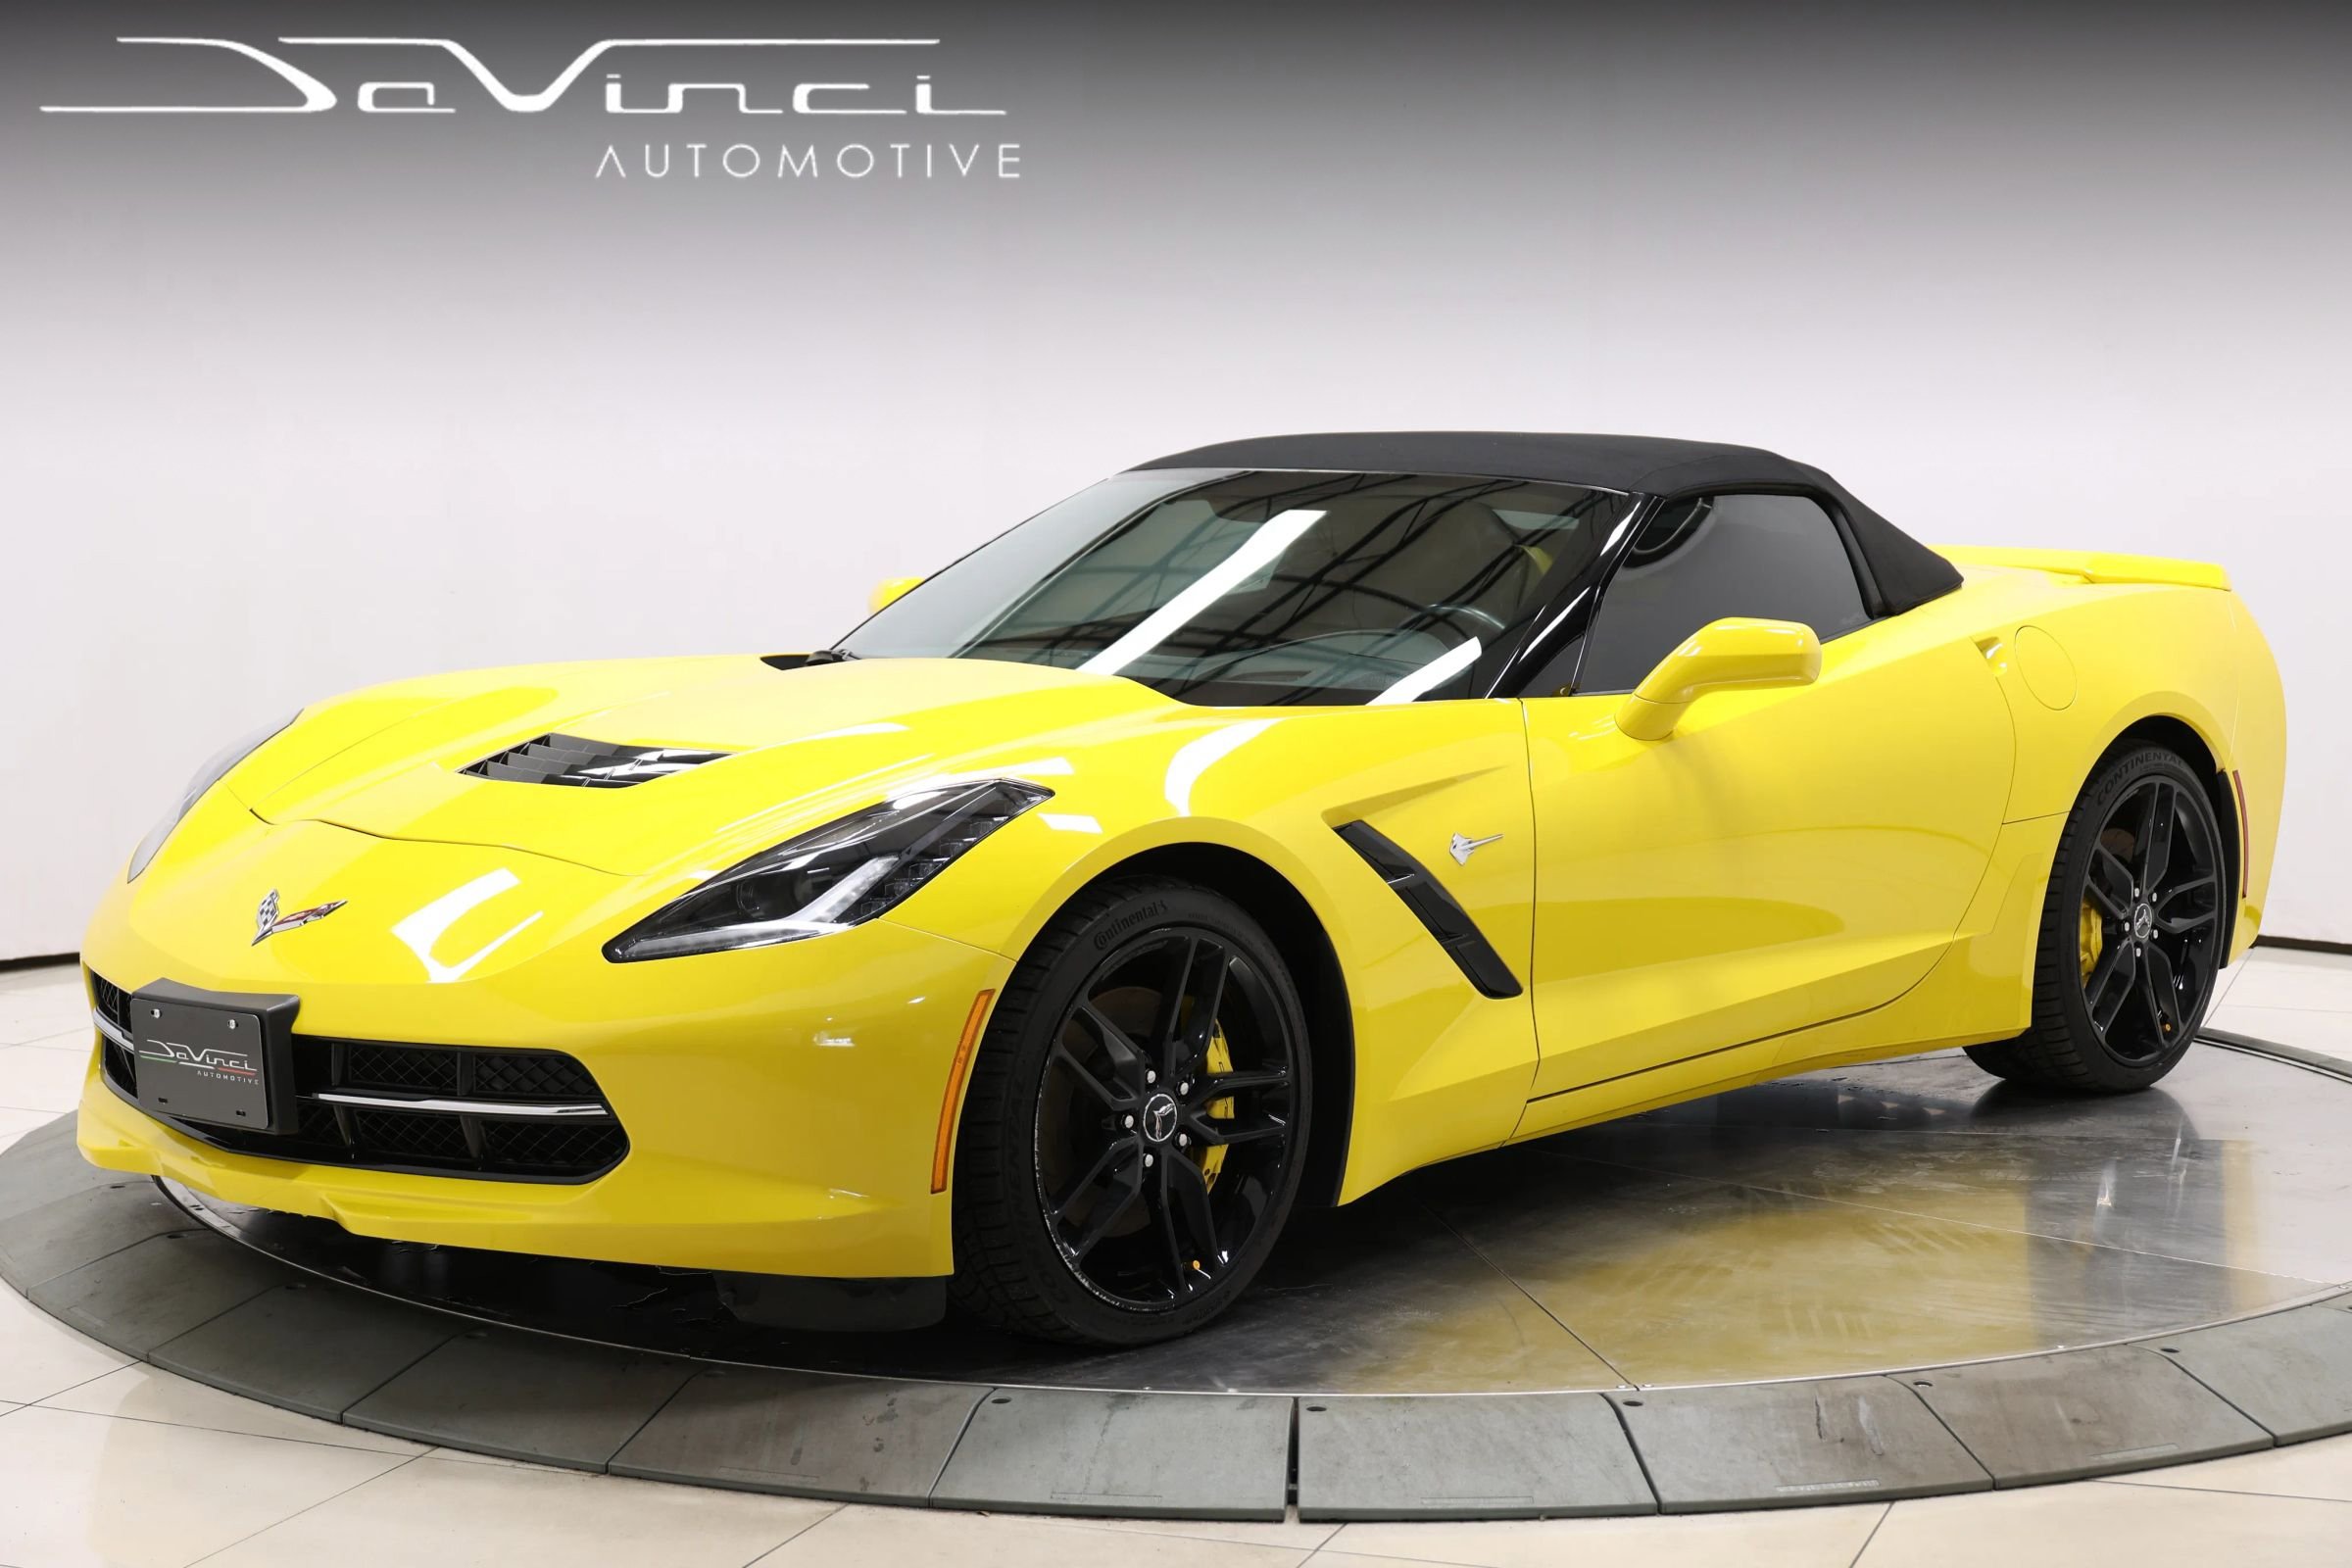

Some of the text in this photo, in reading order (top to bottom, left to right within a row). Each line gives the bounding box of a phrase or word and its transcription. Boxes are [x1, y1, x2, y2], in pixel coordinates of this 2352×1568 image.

[1094, 902, 1159, 951] Continental
[139, 1039, 258, 1071] DaVinci
[197, 1070, 260, 1086] AUTOMOTIVE
